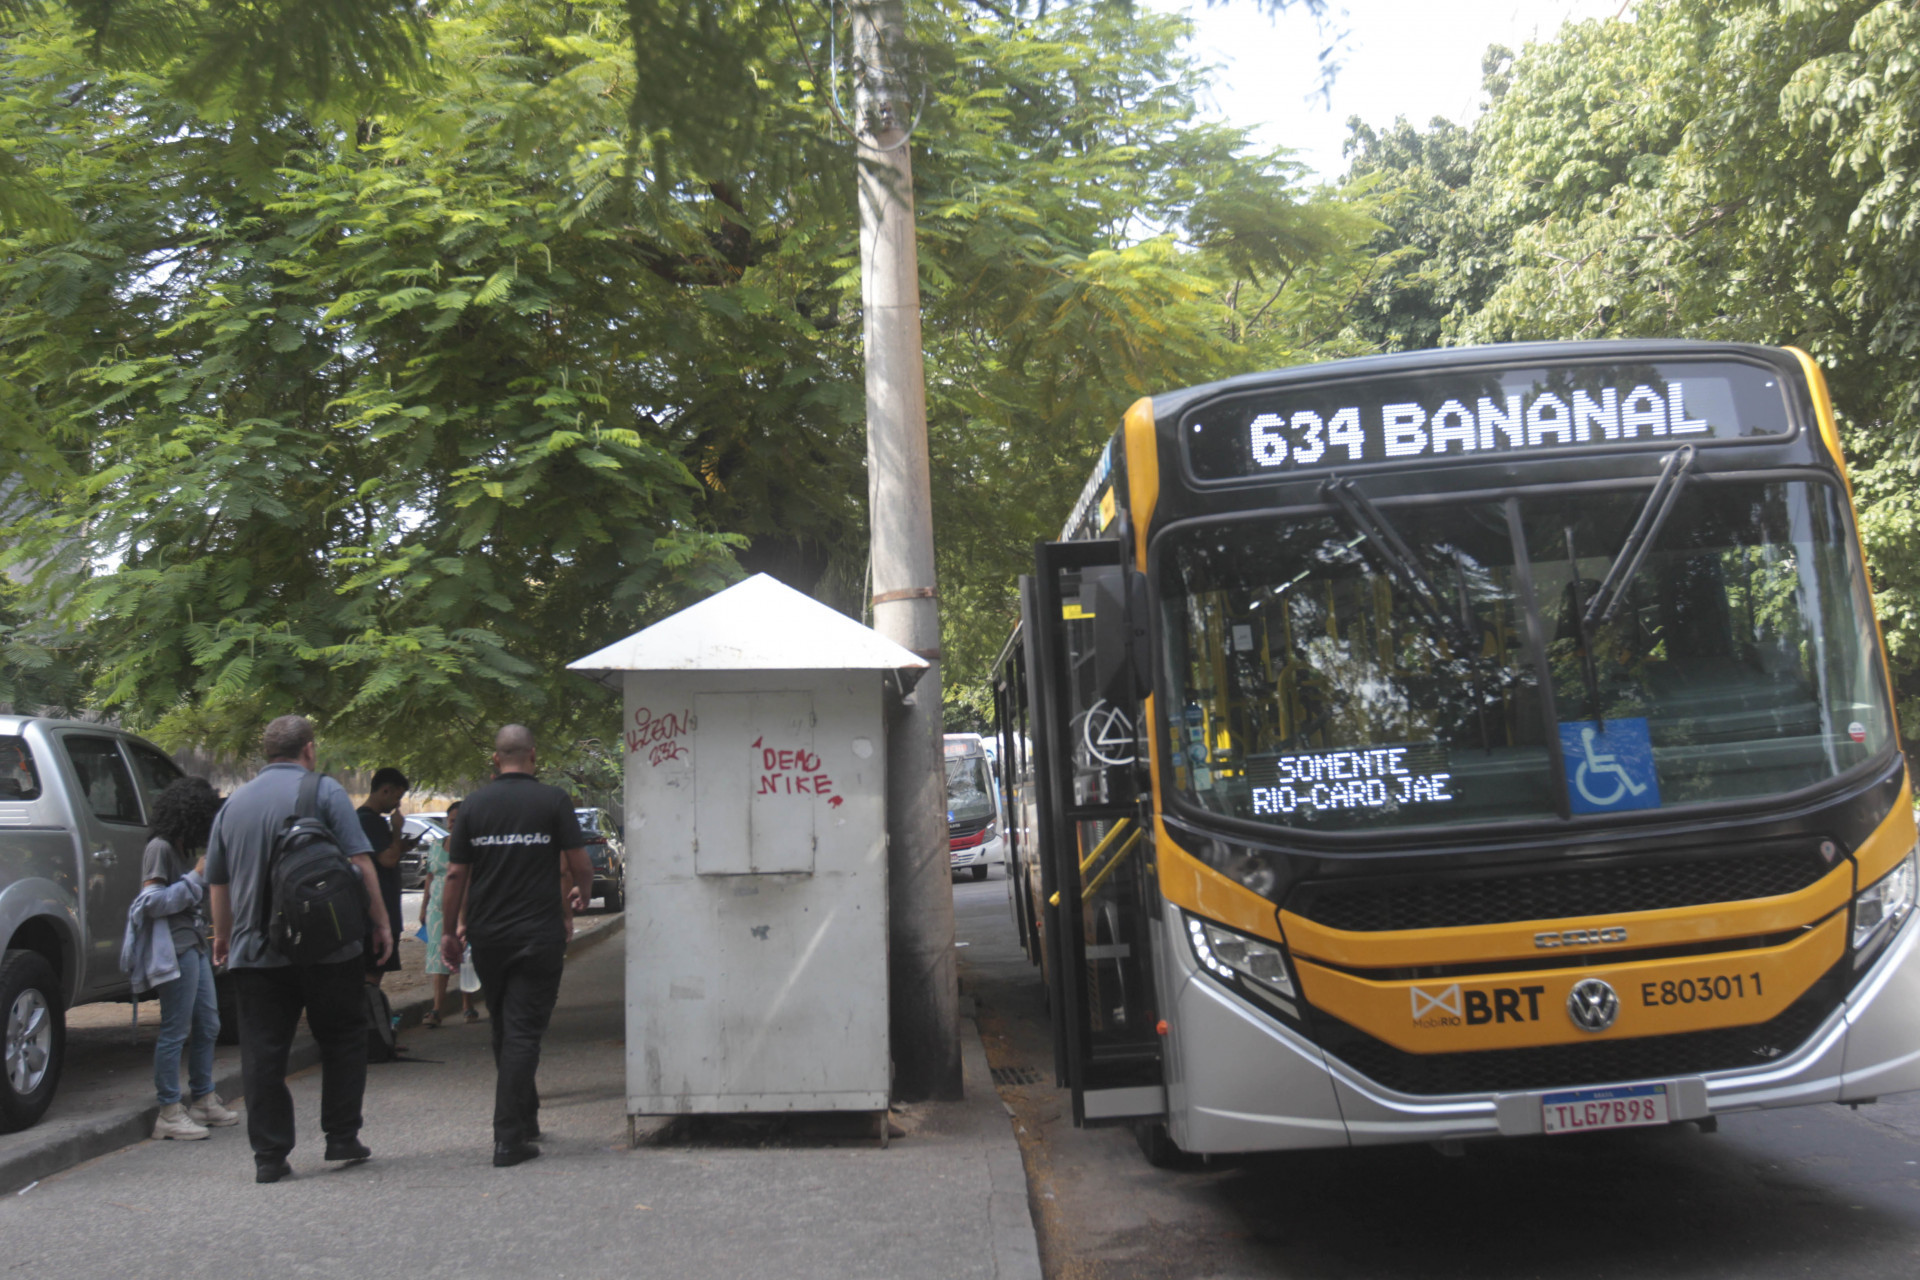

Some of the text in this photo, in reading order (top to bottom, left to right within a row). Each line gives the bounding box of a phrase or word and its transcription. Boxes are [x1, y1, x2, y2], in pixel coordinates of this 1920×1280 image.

[1249, 382, 1708, 468] 634 BANANAL
[1277, 748, 1409, 783] SOMENTE
[757, 773, 832, 794] NIKE
[1252, 773, 1452, 815] RIO-CARD JAE
[1464, 985, 1545, 1025] BRT
[1641, 972, 1762, 1006] E803011
[1555, 1098, 1655, 1128] TLG7B98
